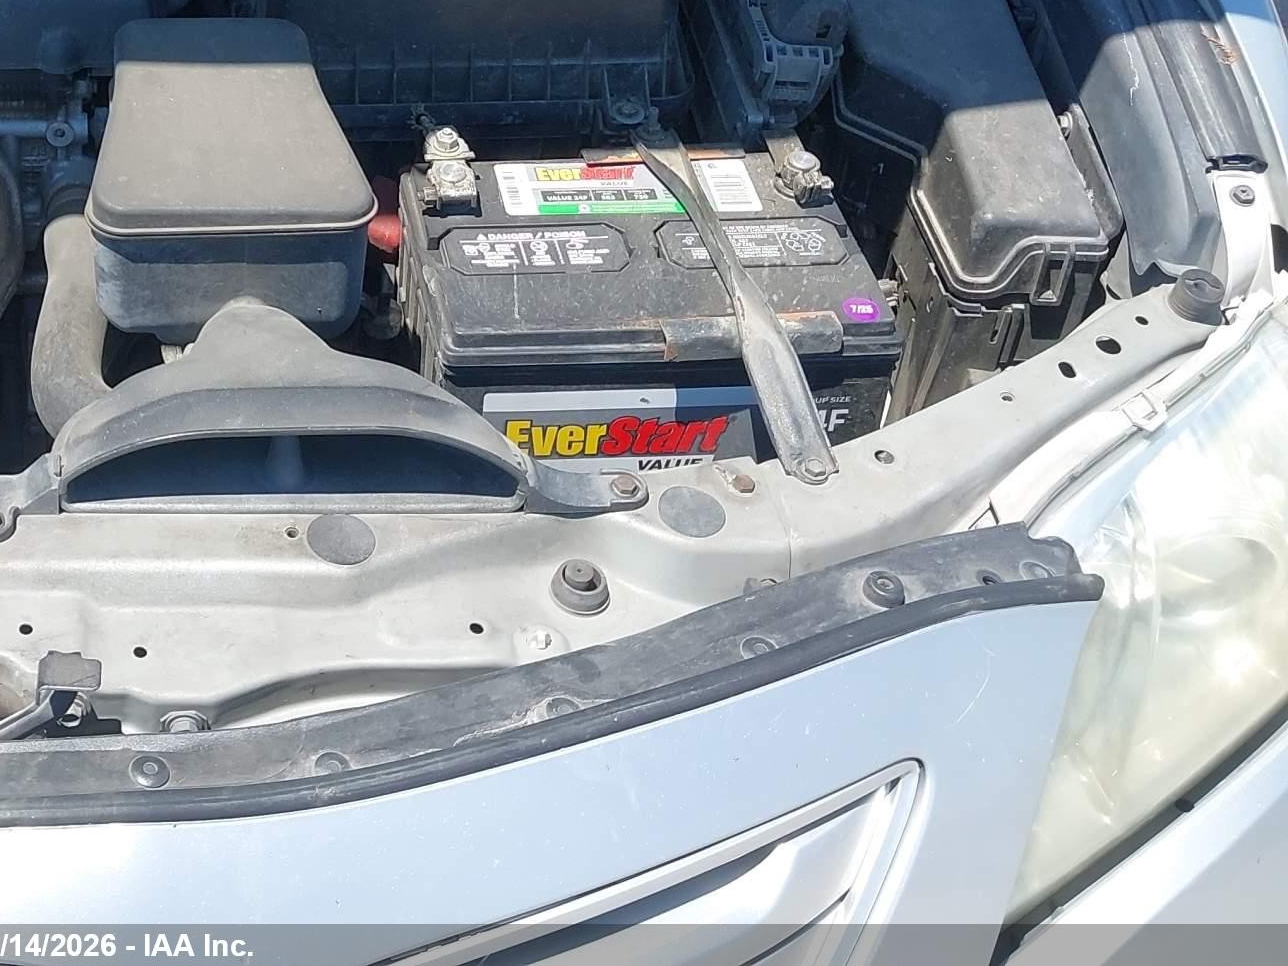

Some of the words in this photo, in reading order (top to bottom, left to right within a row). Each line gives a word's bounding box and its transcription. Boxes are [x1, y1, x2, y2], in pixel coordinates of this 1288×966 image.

[535, 166, 634, 181] EverStart
[487, 232, 535, 241] DANGER
[544, 229, 586, 239] POISON
[505, 414, 729, 458] EverStart
